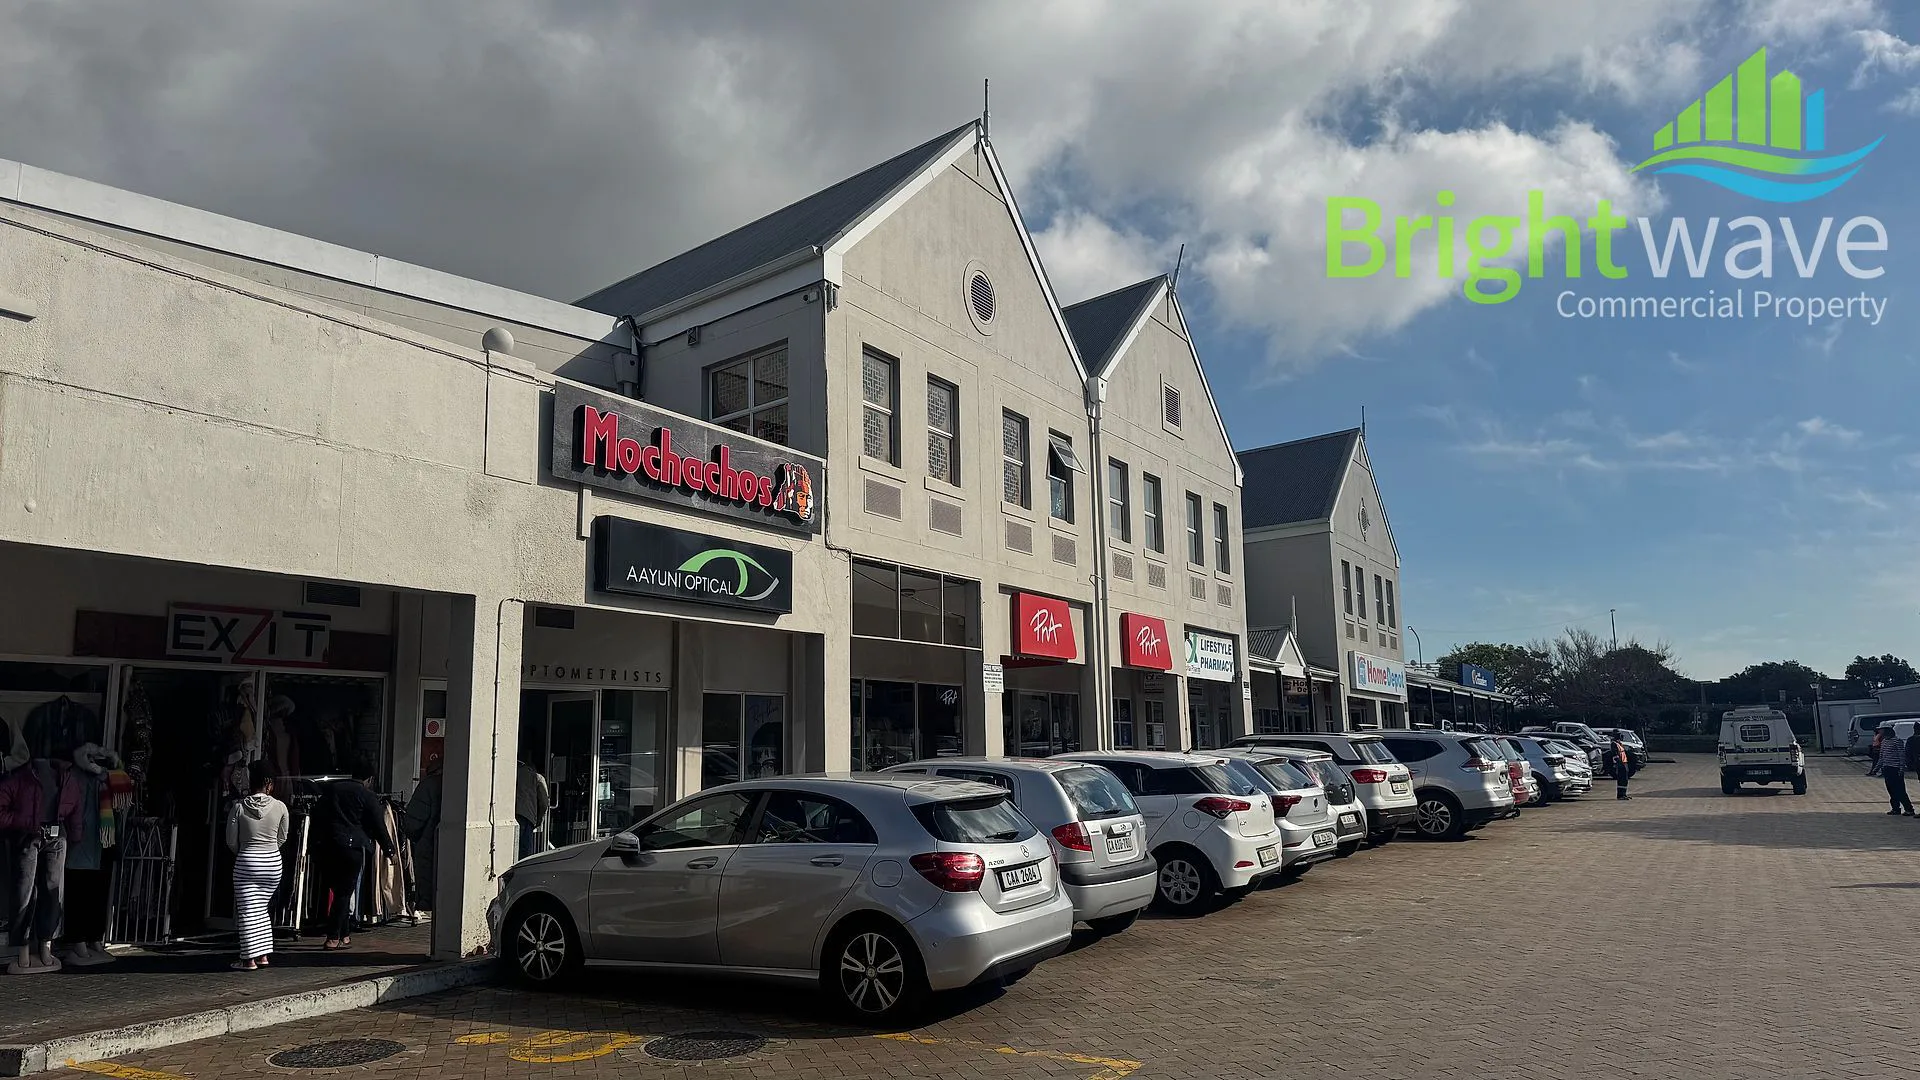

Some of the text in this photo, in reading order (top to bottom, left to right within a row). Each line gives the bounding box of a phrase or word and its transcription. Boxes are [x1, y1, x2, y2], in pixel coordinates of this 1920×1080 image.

[583, 404, 773, 507] Mochachos
[626, 565, 735, 596] AAYUNI OPTICAL
[1200, 638, 1232, 656] LIFESTYLE
[1200, 656, 1234, 673] PHARMACY
